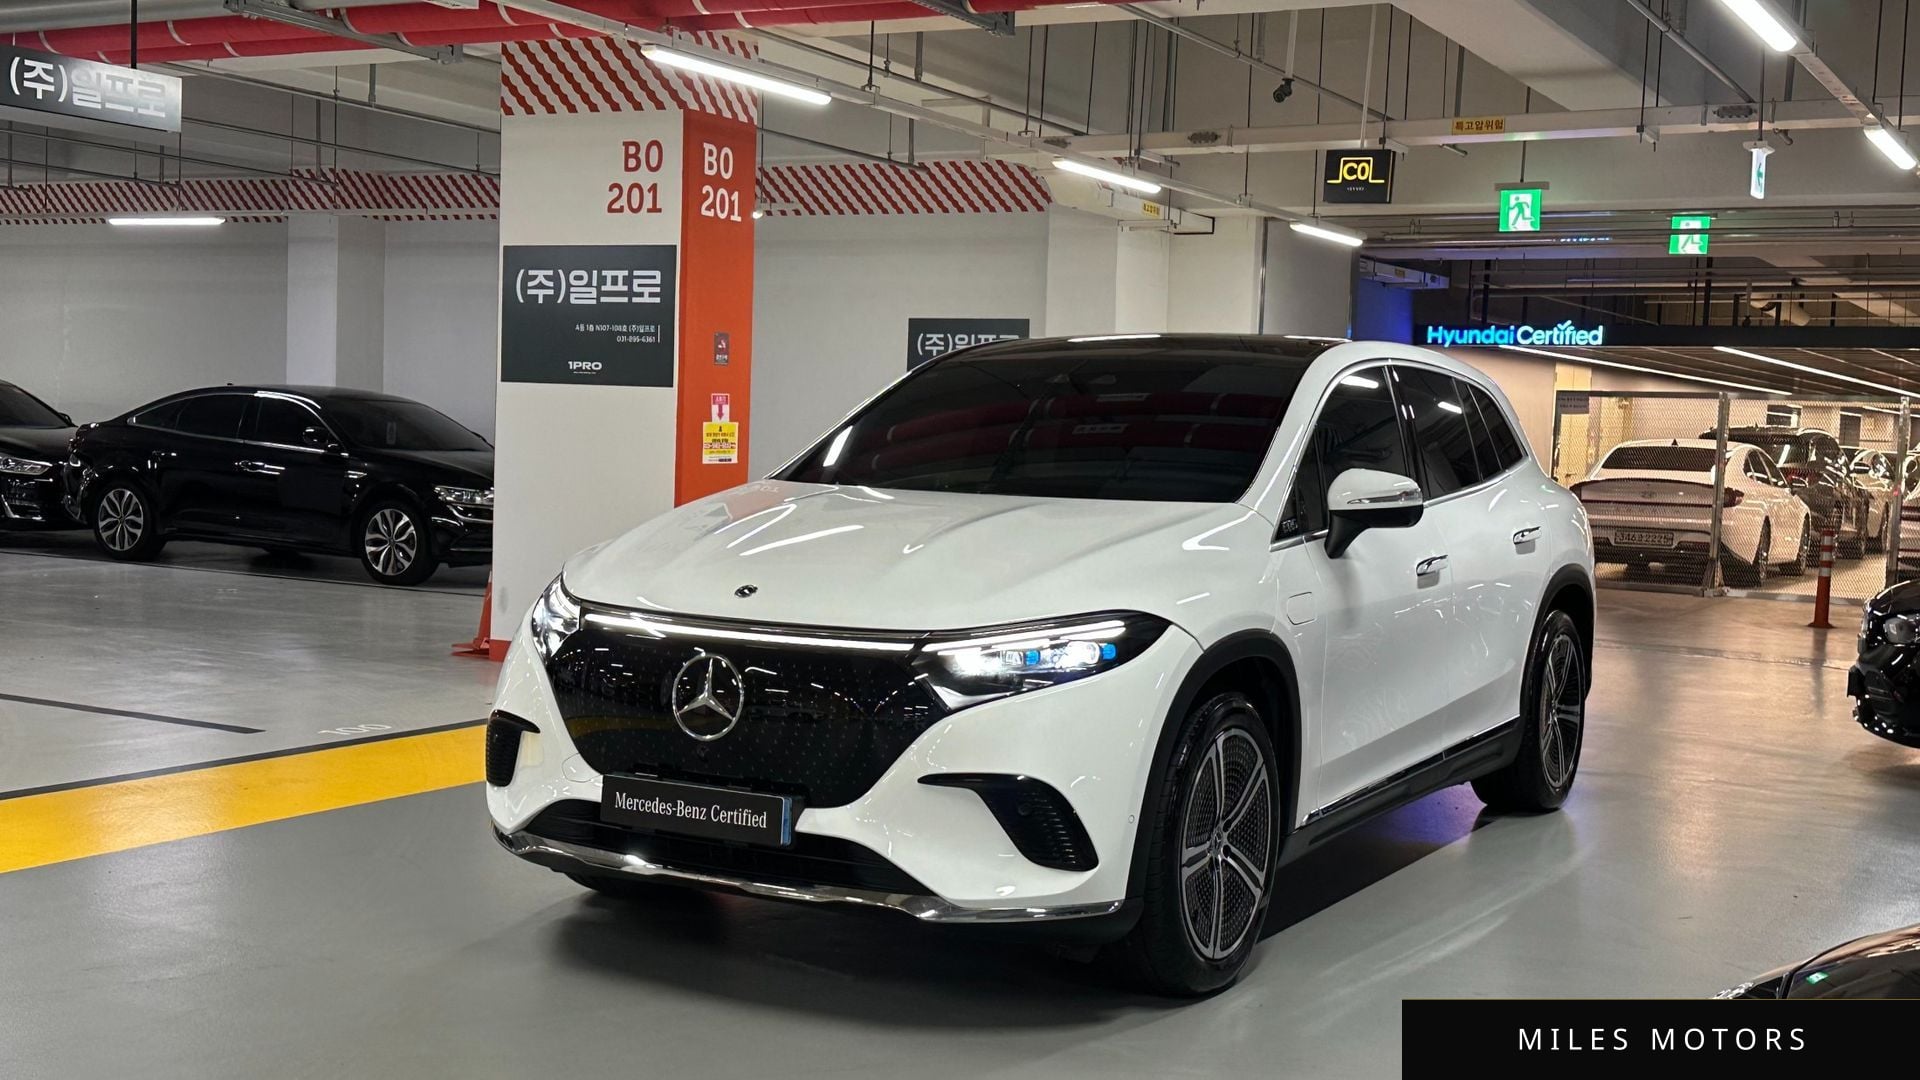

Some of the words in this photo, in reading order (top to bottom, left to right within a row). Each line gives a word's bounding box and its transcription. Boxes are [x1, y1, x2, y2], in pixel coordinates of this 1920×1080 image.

[9, 56, 166, 118] (주)일프로
[606, 183, 663, 214] 201
[701, 185, 742, 222] 201
[515, 268, 662, 305] (주)일프로
[1427, 325, 1515, 347] Hyundai
[1516, 320, 1604, 345] Certified
[568, 361, 602, 370] 1PRO
[318, 723, 392, 736] 100
[615, 791, 707, 821] Mercedes-Benz
[710, 804, 767, 829] Certified
